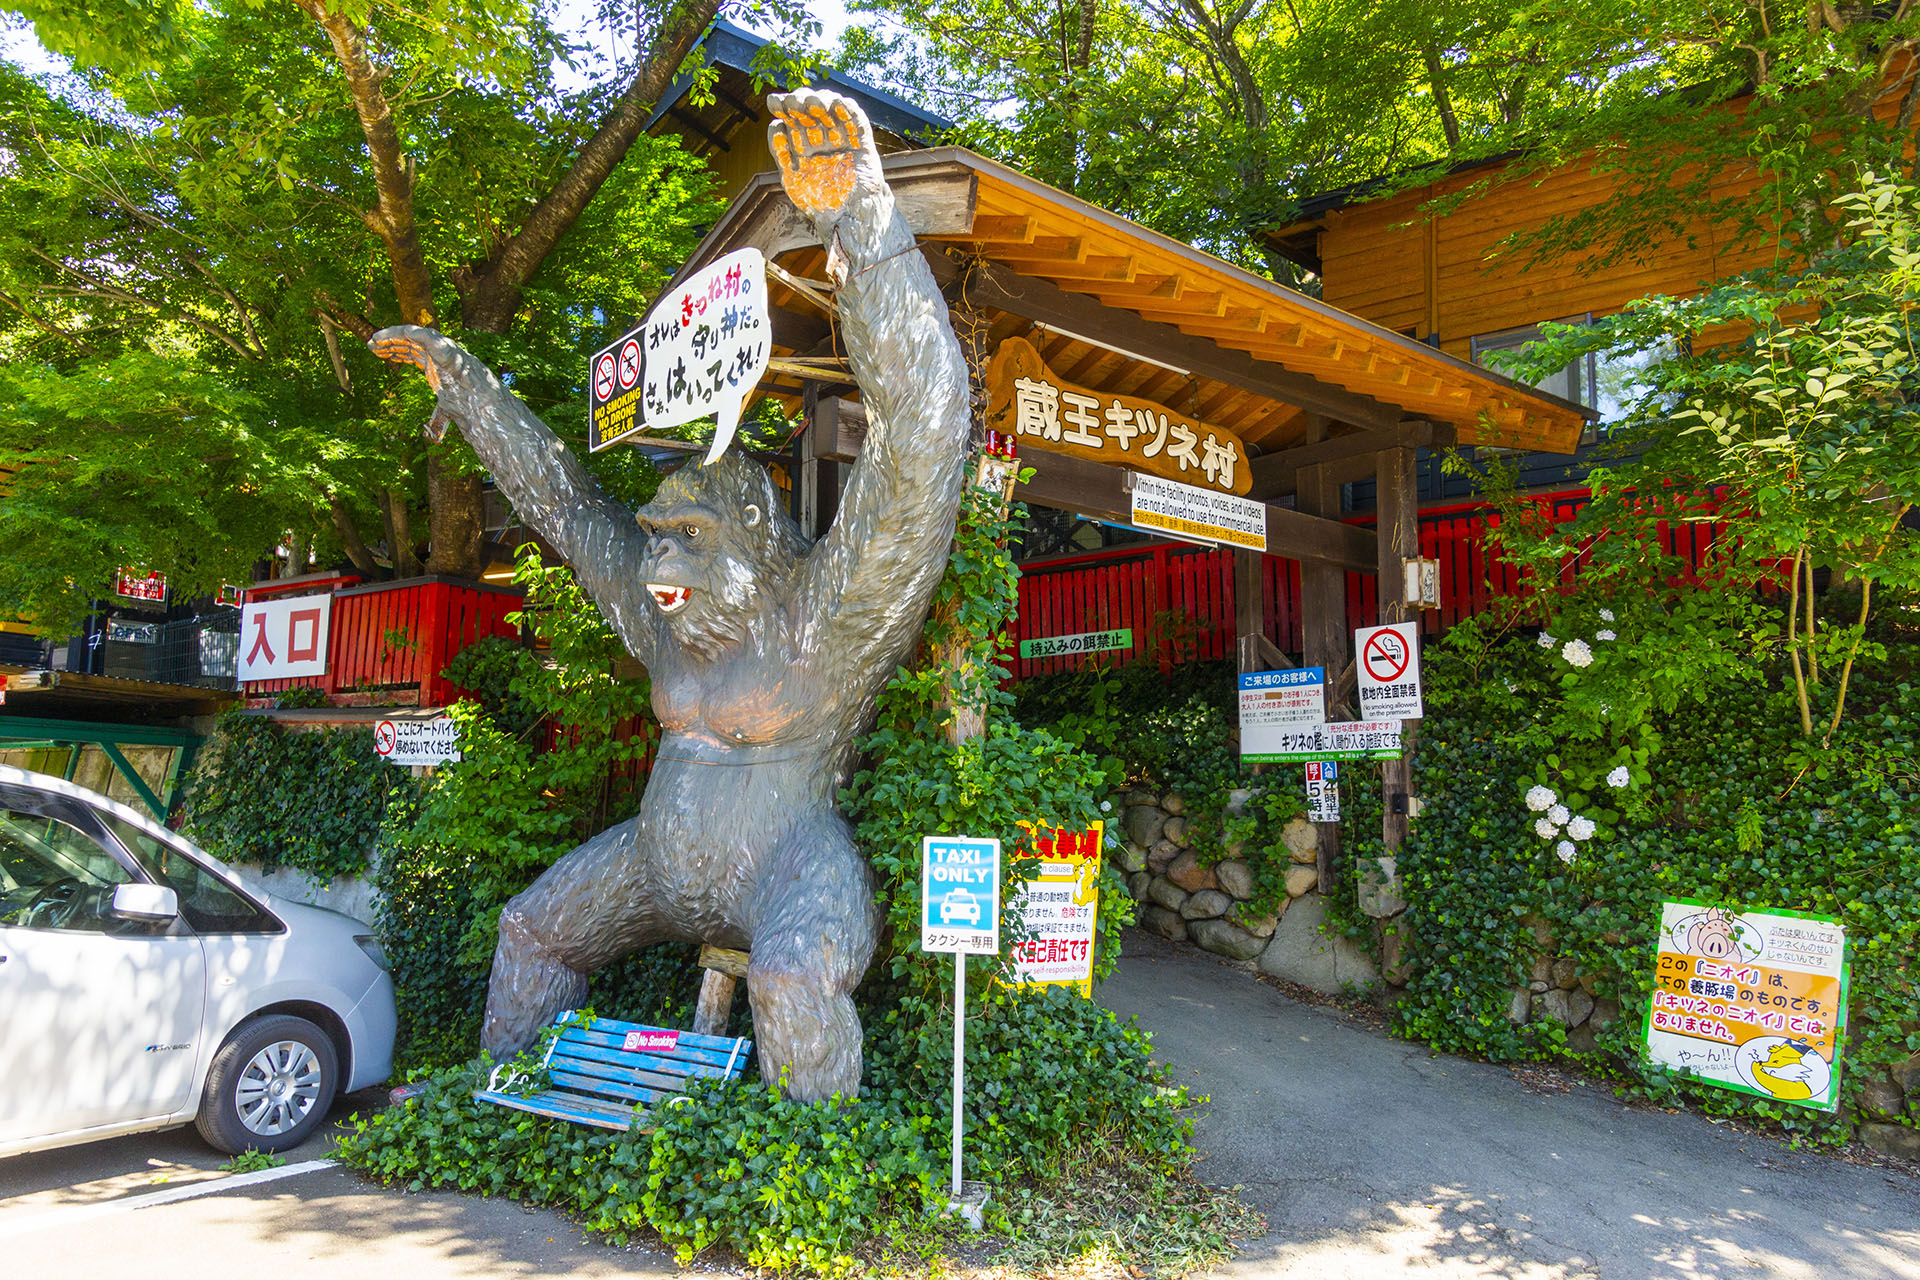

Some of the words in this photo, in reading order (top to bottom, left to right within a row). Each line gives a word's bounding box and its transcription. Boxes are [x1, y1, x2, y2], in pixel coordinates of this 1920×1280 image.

[594, 406, 606, 421] NO
[606, 387, 641, 415] SMOKING
[598, 416, 610, 431] NO
[611, 401, 637, 425] DRONE
[600, 416, 634, 443] 没有无人机
[1014, 376, 1238, 489] 蔵王キツネ村
[1155, 482, 1165, 498] the
[1166, 484, 1186, 504] facility
[1231, 497, 1242, 515] and
[1243, 501, 1261, 520] videos
[1136, 496, 1148, 509] are
[1149, 499, 1160, 513] not
[1161, 500, 1187, 519] allowed
[1188, 506, 1195, 519] to
[1196, 510, 1207, 523] use
[1208, 509, 1217, 524] for
[1218, 513, 1253, 533] commercial
[246, 608, 321, 668] 入口
[1030, 632, 1124, 657] 持込みの餌禁止
[1244, 671, 1317, 686] ご来場のお客様へ
[1362, 683, 1417, 701] 敷地内全面禁煙
[1309, 763, 1319, 780] 終了
[1324, 762, 1334, 779] 入場
[933, 848, 980, 864] TAXI
[933, 867, 989, 883] ONLY
[1048, 863, 1071, 873] clause
[928, 933, 993, 949] タクシー専用
[1768, 938, 1833, 954] キツネくんのせい
[1767, 950, 1828, 966] じゃないんです。
[1655, 1012, 1735, 1041] ありません。
[638, 1035, 648, 1046] No
[648, 1035, 677, 1048] Smoking
